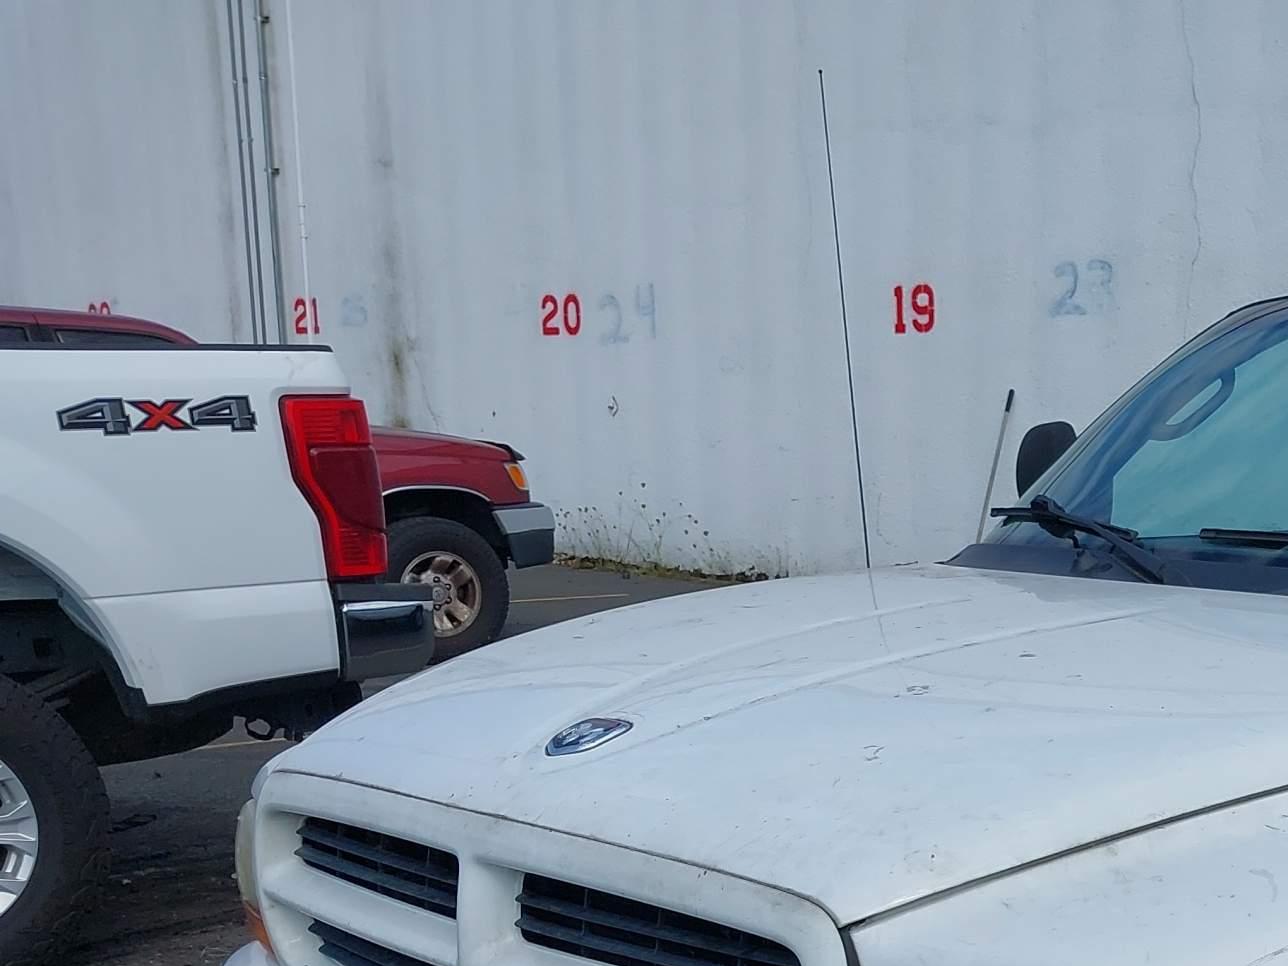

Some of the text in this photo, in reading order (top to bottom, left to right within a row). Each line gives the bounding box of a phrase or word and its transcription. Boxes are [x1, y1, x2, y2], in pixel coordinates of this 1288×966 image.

[293, 297, 320, 335] 21
[541, 293, 582, 337] 20
[598, 280, 658, 343] 24
[893, 283, 935, 335] 19
